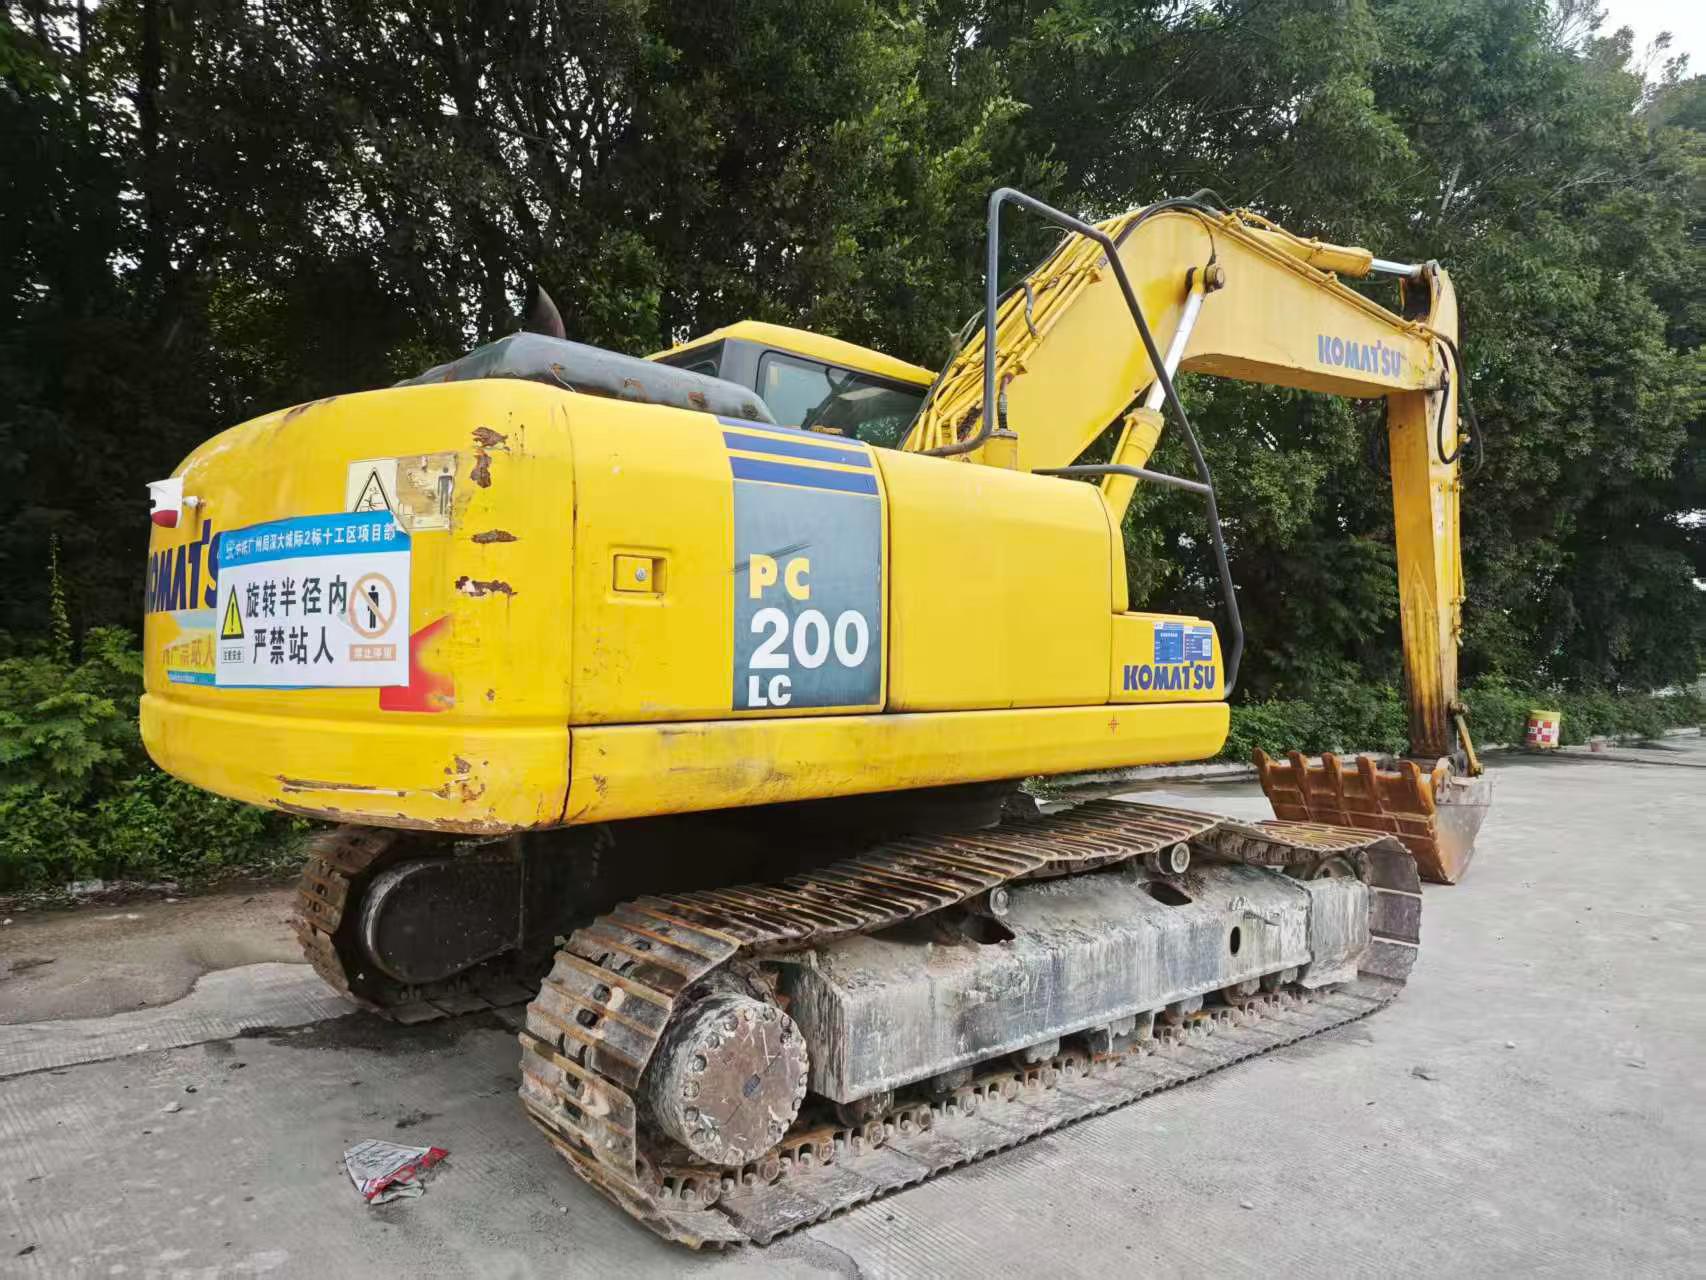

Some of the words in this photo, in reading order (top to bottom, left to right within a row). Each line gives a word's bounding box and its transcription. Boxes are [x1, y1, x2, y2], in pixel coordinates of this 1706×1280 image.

[1317, 335, 1401, 377] KOMATSU
[246, 574, 347, 618] 旋转半径内
[749, 553, 810, 600] PC
[252, 626, 334, 664] 严禁站人
[749, 607, 869, 669] 200
[748, 674, 791, 707] LC
[1123, 660, 1215, 690] KOMATSU
